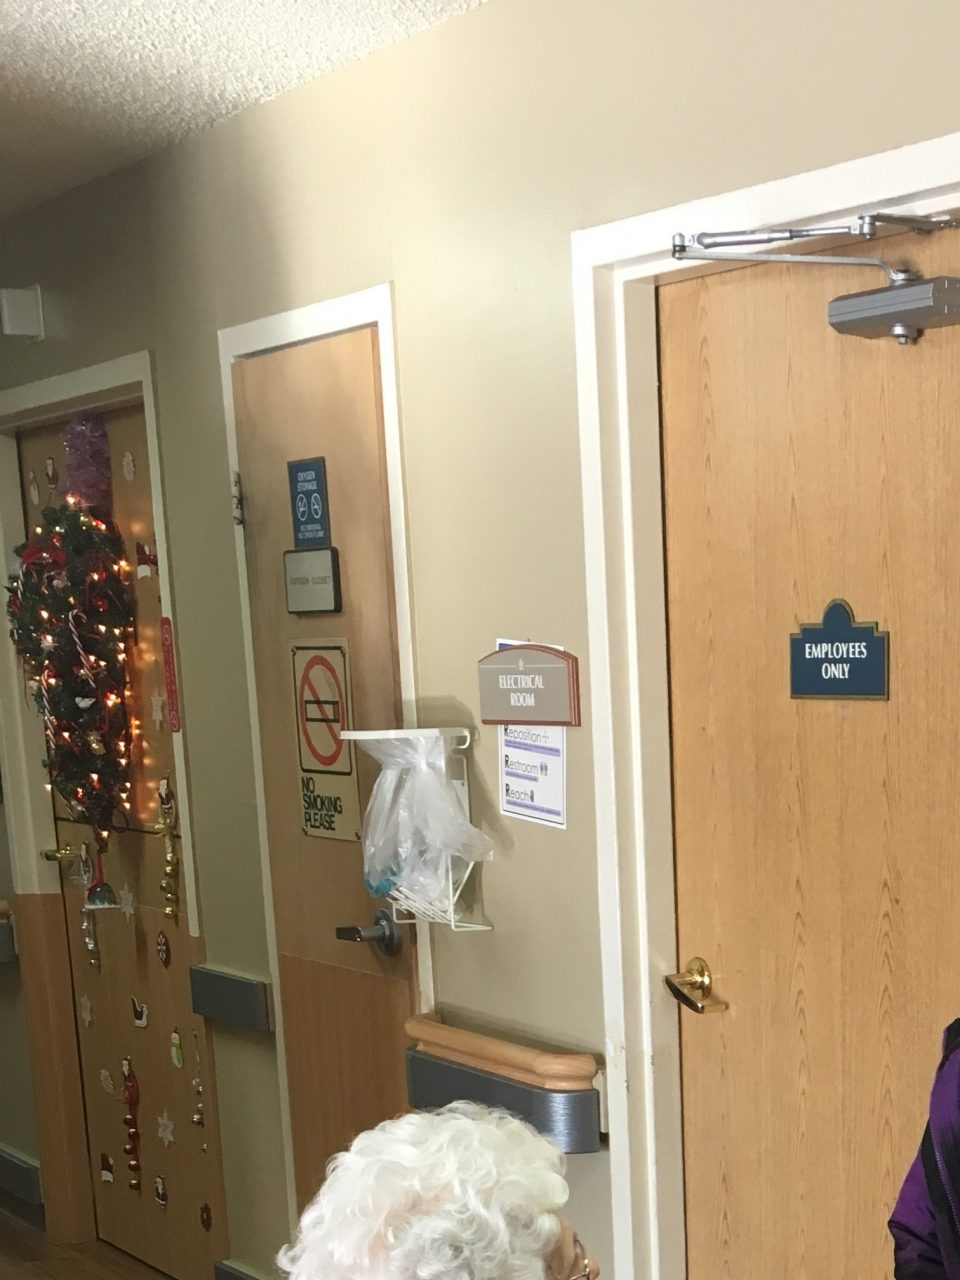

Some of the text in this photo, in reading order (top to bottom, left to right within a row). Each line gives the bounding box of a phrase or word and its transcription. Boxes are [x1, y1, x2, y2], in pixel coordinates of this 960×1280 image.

[805, 642, 867, 659] EMPLOYEES
[821, 663, 850, 679] ONLY
[499, 675, 544, 689] ELECTRICAL
[510, 693, 535, 707] ROOM
[504, 725, 541, 742] Reposition
[505, 754, 538, 773] Restroom
[301, 776, 315, 794] NO
[505, 783, 529, 802] Reach
[303, 793, 342, 814] SMOKING
[304, 811, 336, 831] PLEASE
